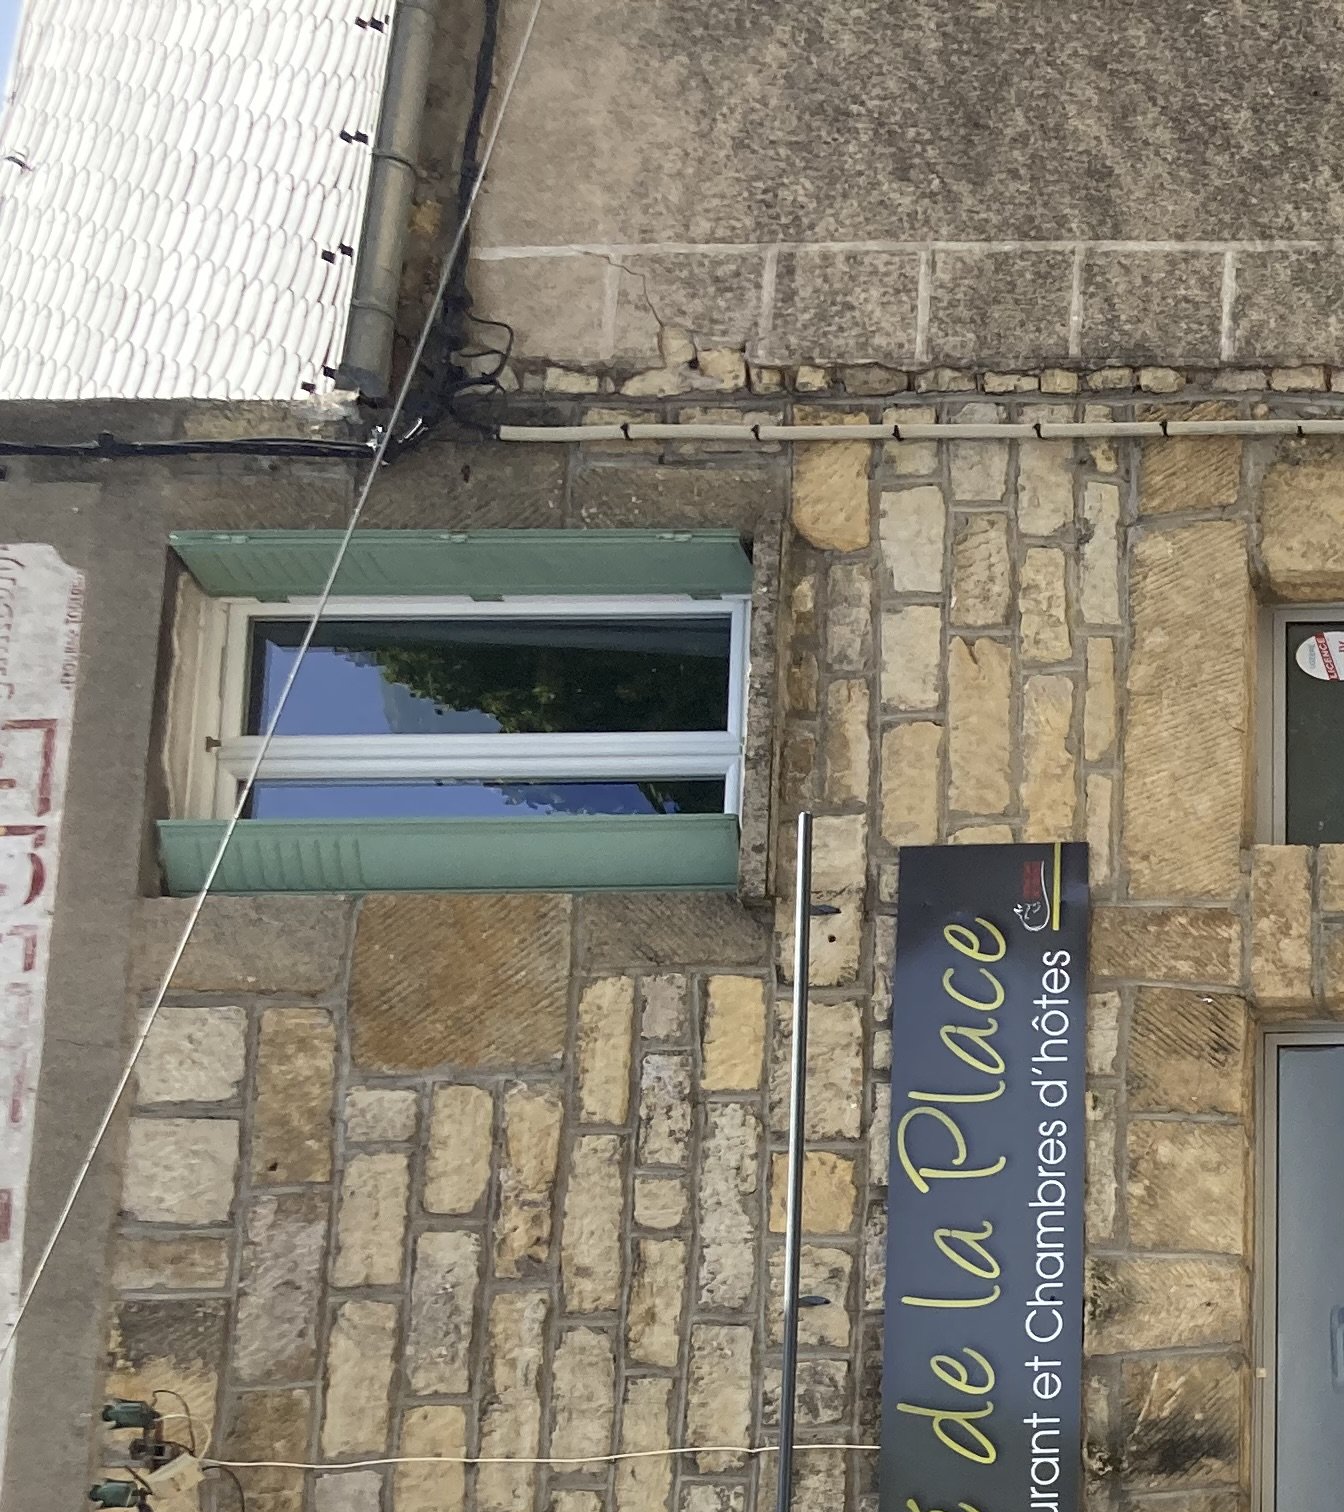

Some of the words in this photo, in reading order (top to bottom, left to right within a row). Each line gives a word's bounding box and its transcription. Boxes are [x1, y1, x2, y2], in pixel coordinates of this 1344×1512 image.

[1316, 637, 1338, 679] LICENCE
[897, 917, 1007, 1193] Place
[1031, 949, 1071, 1107] d'hôtes
[901, 1220, 1000, 1308] la
[1025, 1120, 1068, 1343] Chambres
[896, 1347, 997, 1464] de
[1024, 1355, 1062, 1400] et
